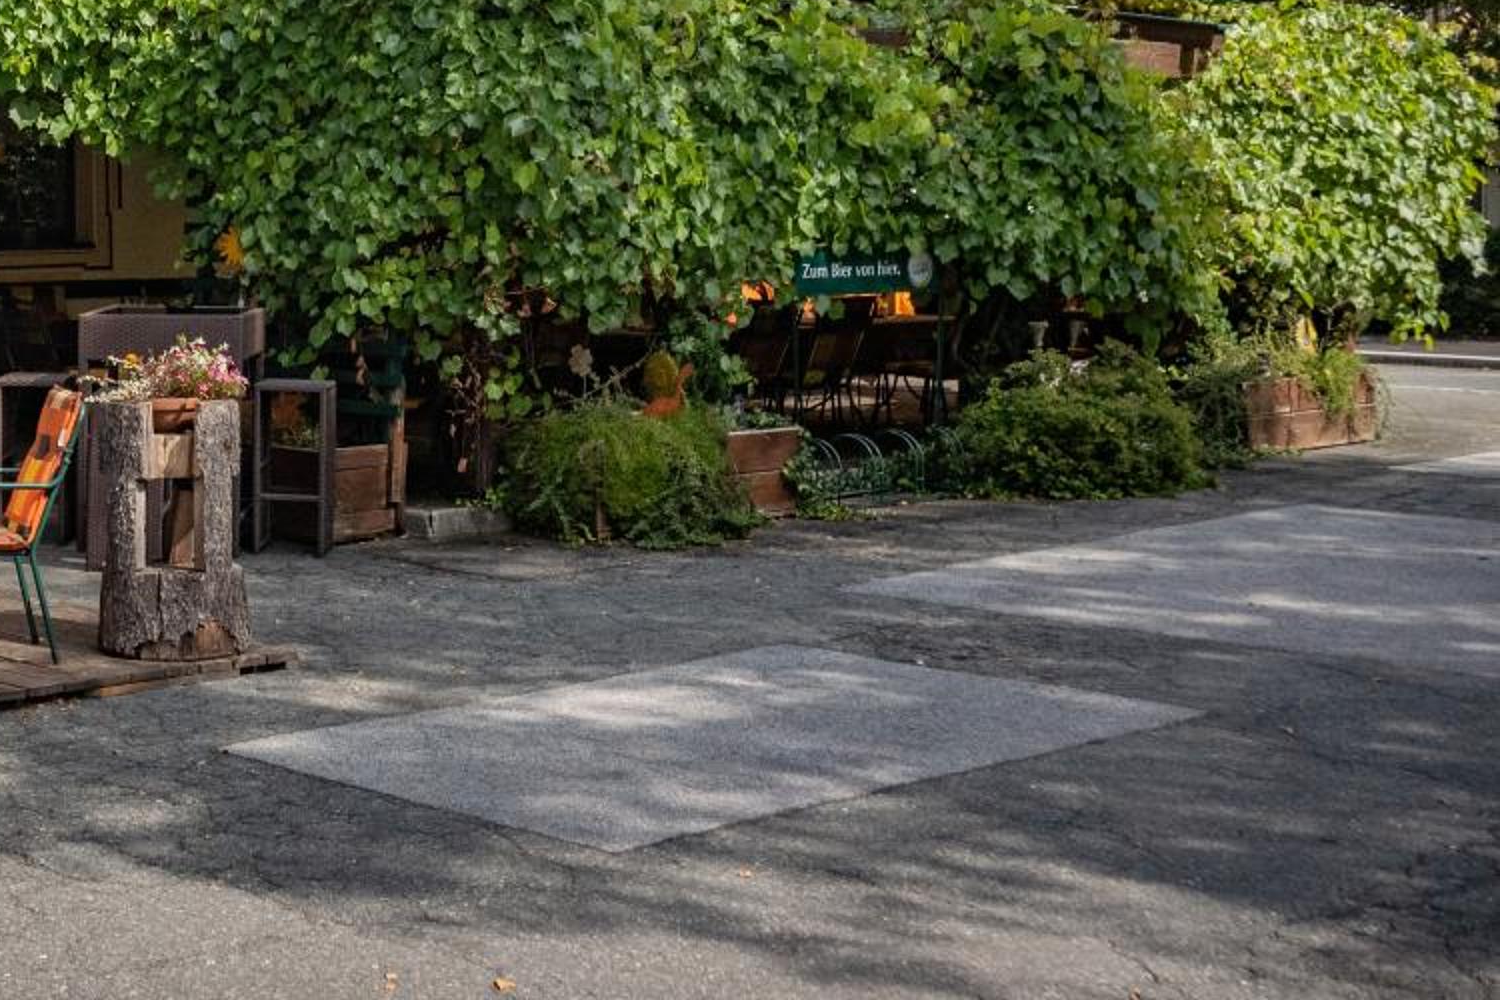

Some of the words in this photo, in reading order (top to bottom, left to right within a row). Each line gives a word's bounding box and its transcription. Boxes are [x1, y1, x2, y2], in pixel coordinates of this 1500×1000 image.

[801, 263, 829, 279] Zum
[831, 262, 853, 278] Bier
[855, 264, 875, 277] von
